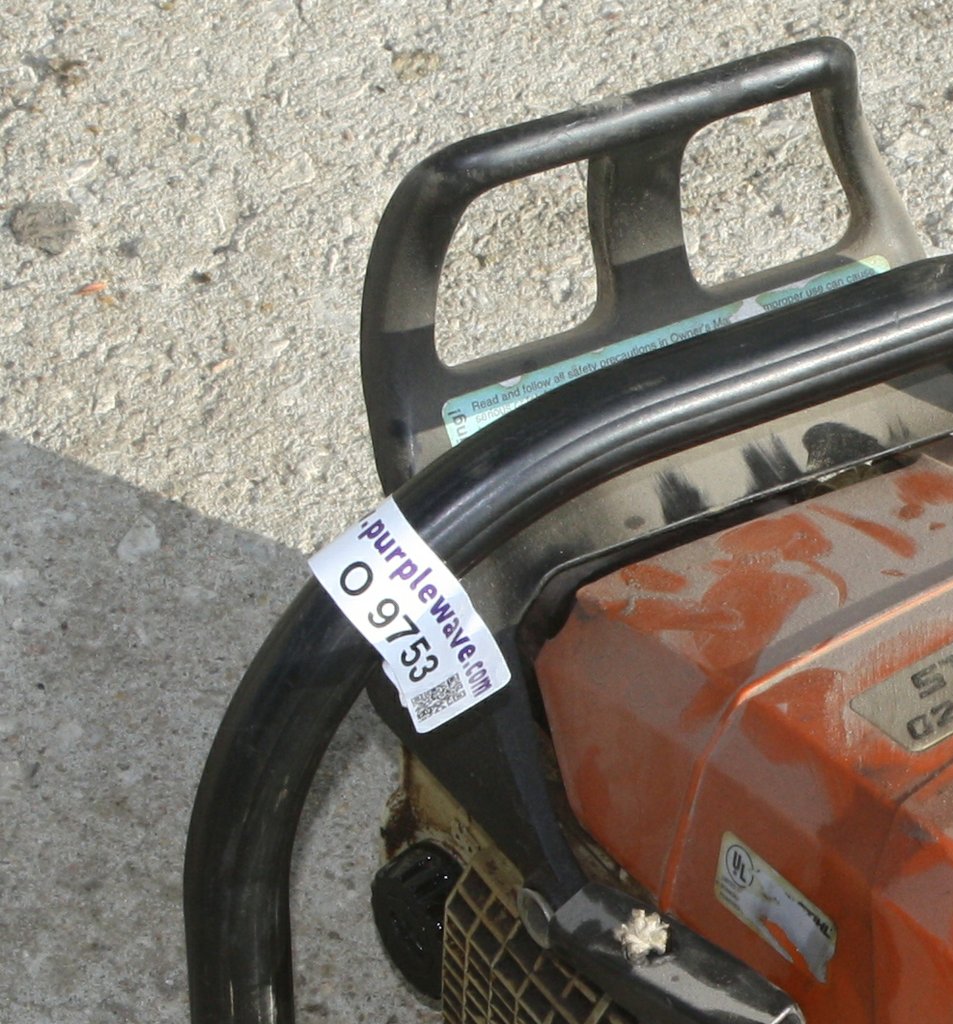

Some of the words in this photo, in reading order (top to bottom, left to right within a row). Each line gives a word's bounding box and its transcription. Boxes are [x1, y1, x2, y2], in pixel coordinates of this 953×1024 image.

[471, 394, 499, 412] Read
[501, 387, 521, 401] and
[522, 379, 551, 395] follow
[567, 362, 597, 379] safety
[600, 341, 657, 368] precautions
[659, 337, 668, 348] in
[670, 320, 710, 342] Owner's
[762, 292, 803, 311] mproper
[806, 285, 823, 298] use
[826, 279, 844, 291] can
[847, 269, 876, 284] cause
[357, 519, 493, 697] .purplewave.com
[367, 598, 439, 683] 9753
[732, 851, 748, 883] UL
